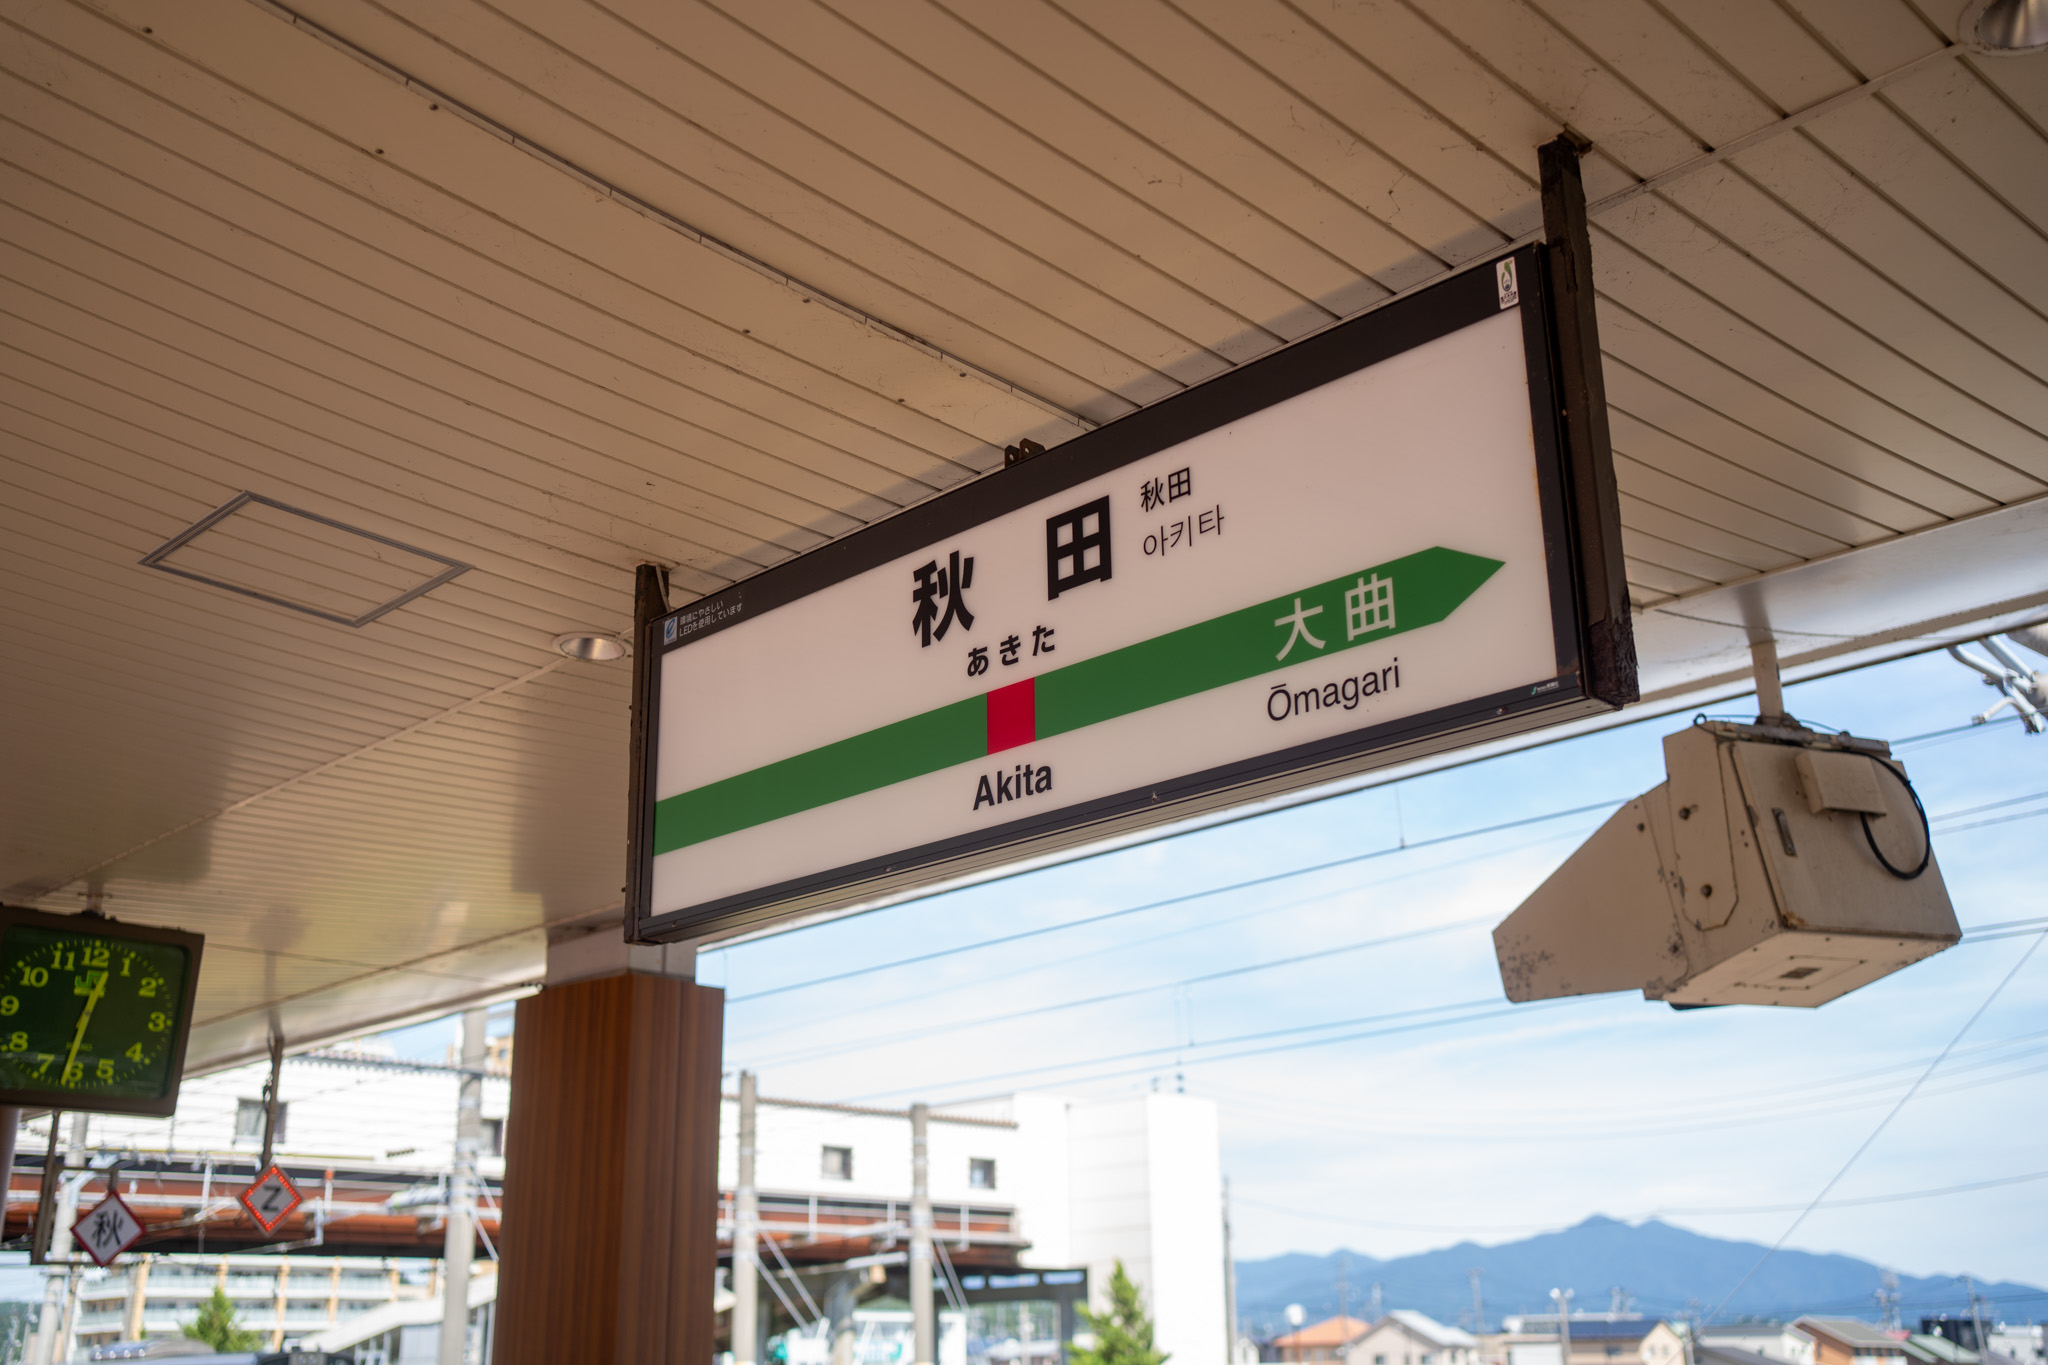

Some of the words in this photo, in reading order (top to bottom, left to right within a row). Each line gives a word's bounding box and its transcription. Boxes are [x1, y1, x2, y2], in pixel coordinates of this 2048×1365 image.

[1140, 467, 1192, 512] 秋田
[1143, 504, 1225, 556] 아키타
[912, 495, 1112, 648] 秋田
[1274, 573, 1396, 662] 大曲
[966, 625, 1056, 677] あきた
[1267, 657, 1400, 721] Ōmagari
[973, 764, 1052, 811] Akita
[51, 950, 75, 971] 11
[81, 946, 110, 967] 12
[120, 957, 131, 977] 1
[20, 966, 48, 988] 10
[139, 977, 157, 997] 2
[0, 995, 19, 1016] 9
[148, 1012, 166, 1032] 3
[9, 1031, 28, 1052] 8
[125, 1042, 142, 1063] 4
[37, 1053, 54, 1074] 7
[68, 1061, 83, 1081] 6
[96, 1058, 114, 1079] 5
[92, 1210, 124, 1247] 秋
